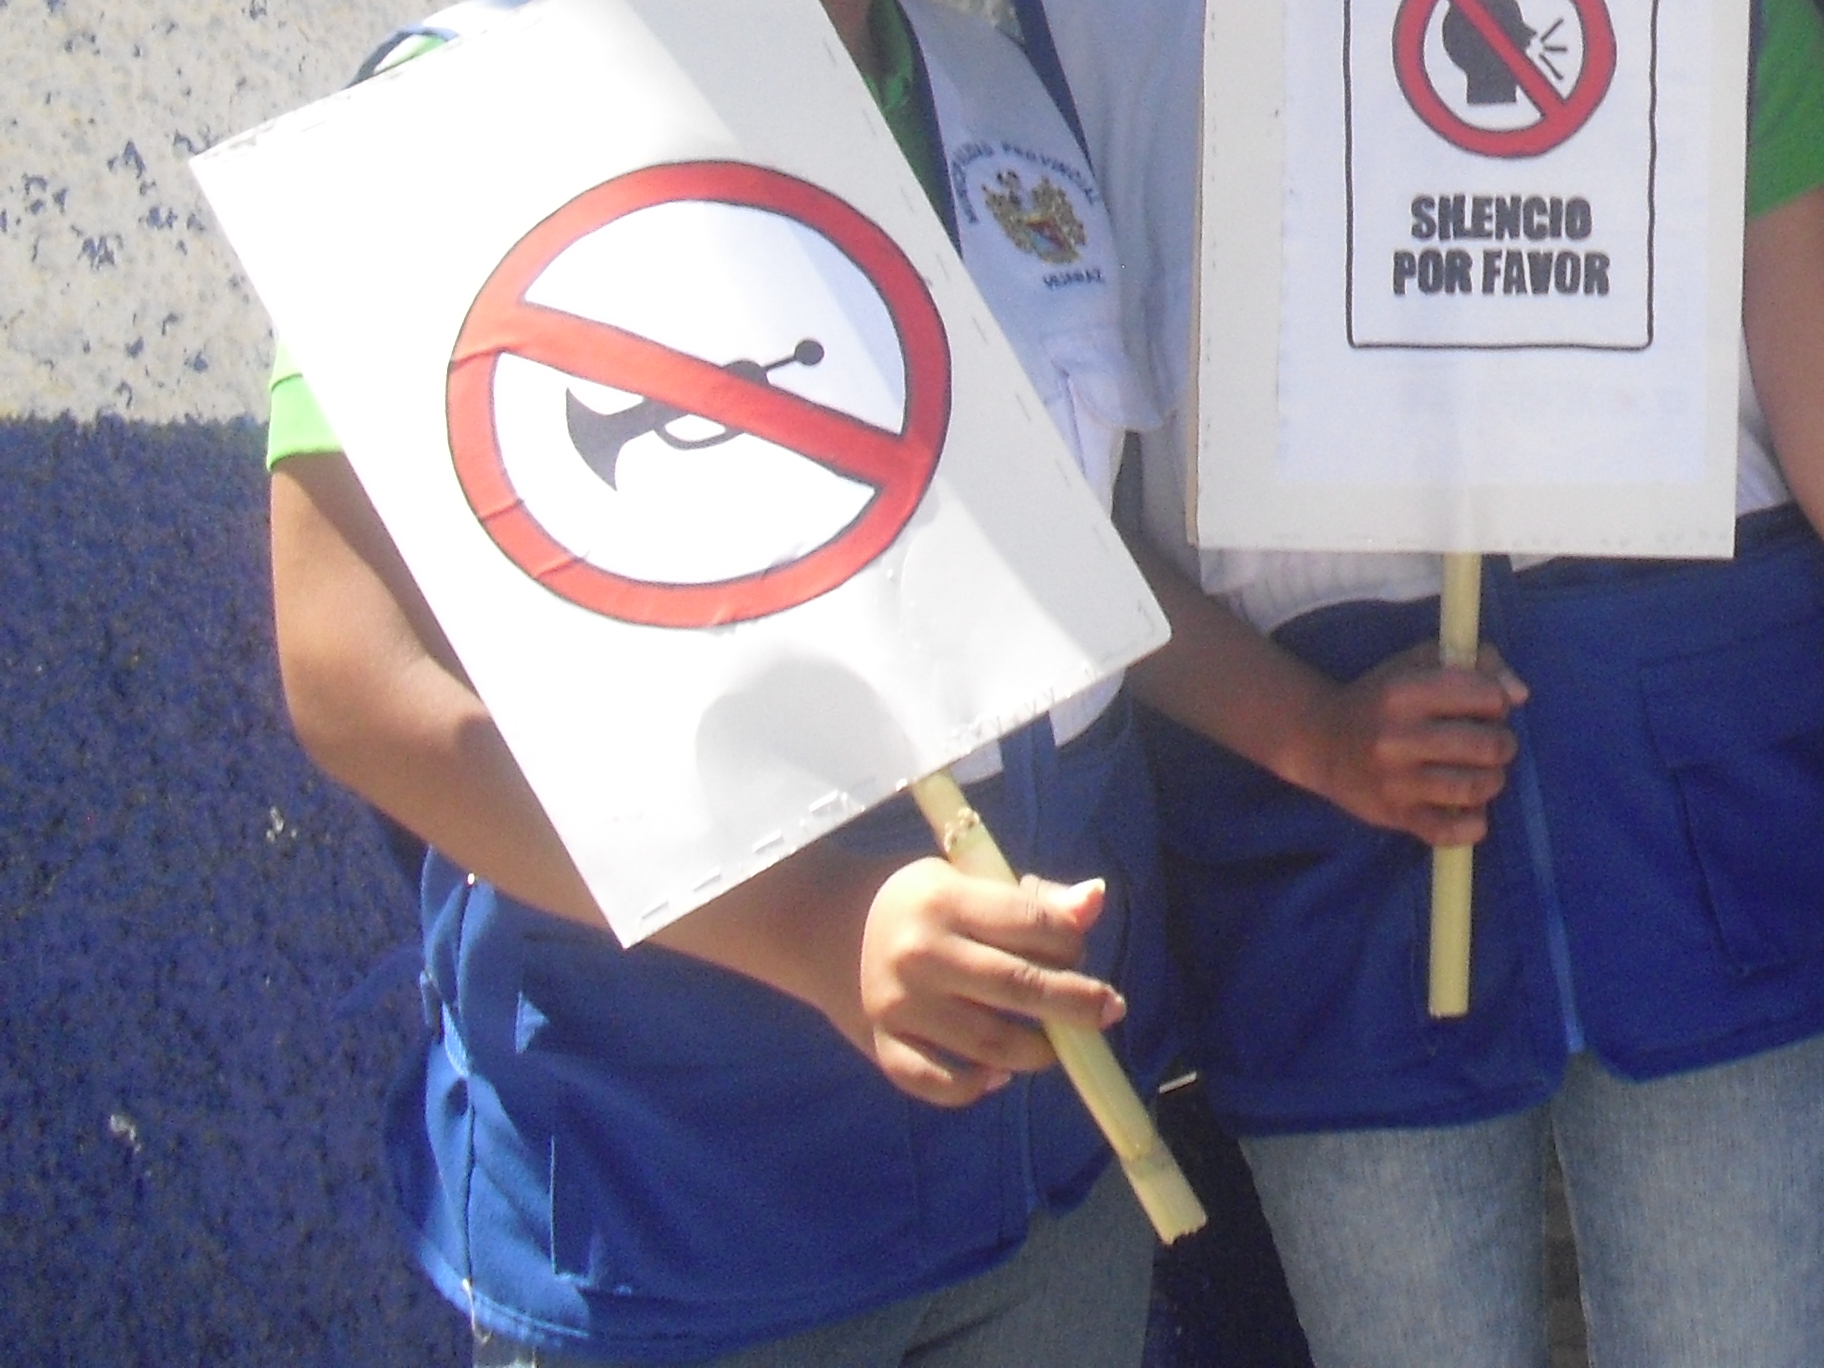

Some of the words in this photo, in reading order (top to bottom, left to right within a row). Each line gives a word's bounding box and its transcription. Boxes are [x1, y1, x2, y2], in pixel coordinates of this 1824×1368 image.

[1411, 194, 1592, 240] SILENCIO
[1393, 248, 1473, 294] POR
[1482, 249, 1610, 295] FAVOR
